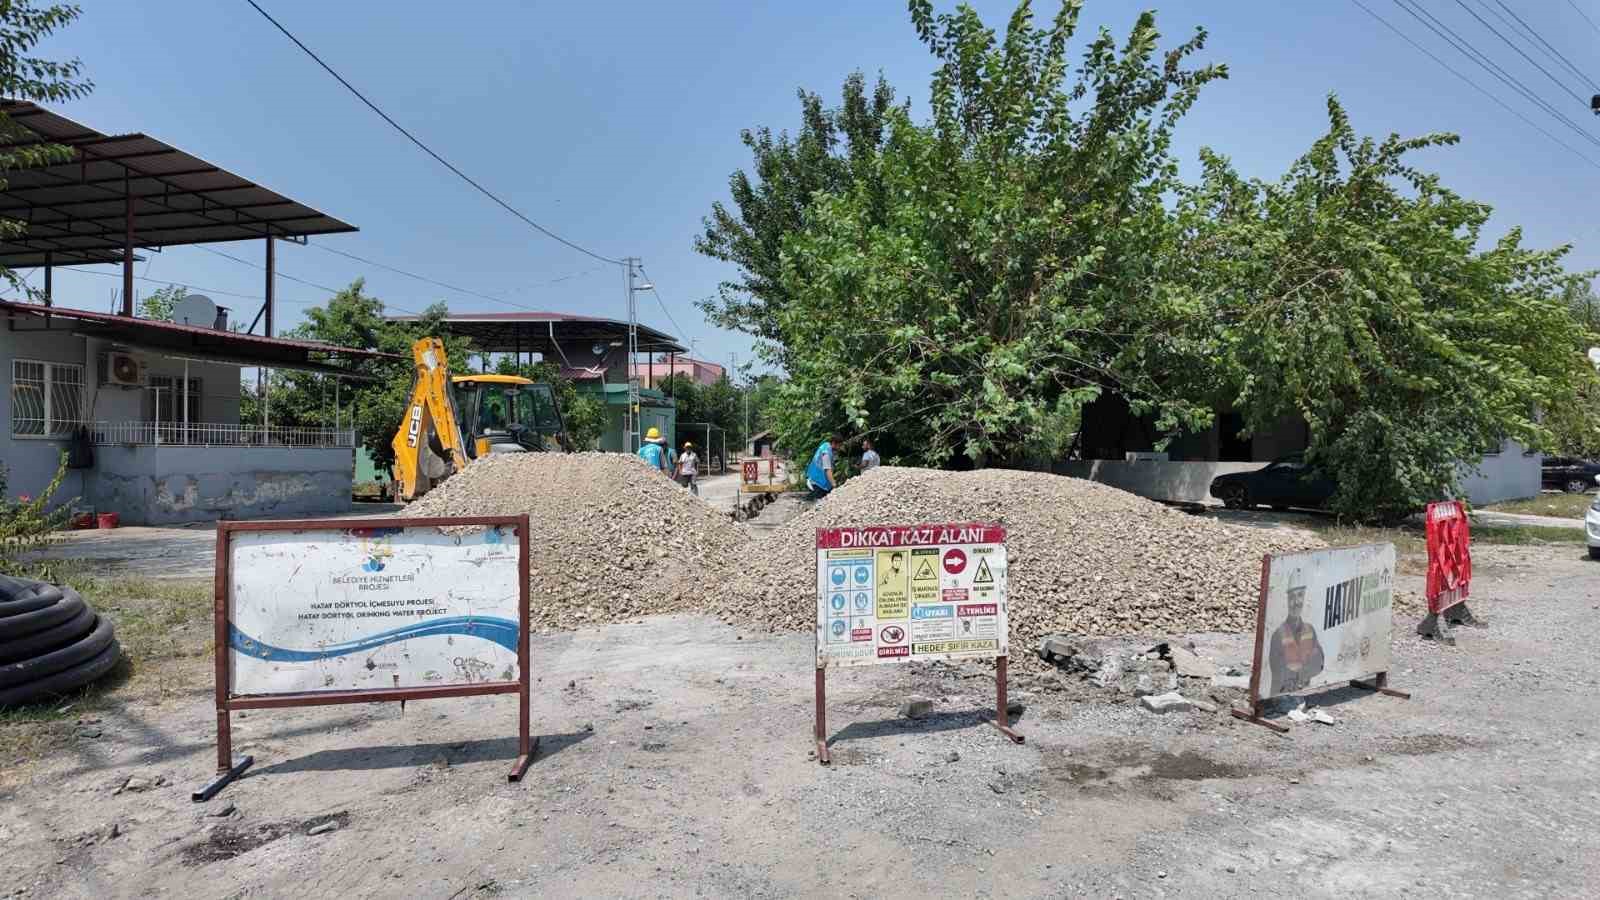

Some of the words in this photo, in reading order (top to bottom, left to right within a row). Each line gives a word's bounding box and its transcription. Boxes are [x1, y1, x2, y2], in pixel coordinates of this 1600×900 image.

[408, 406, 421, 447] JCB
[841, 529, 896, 547] DİKKAT
[900, 528, 934, 545] KAZI
[938, 527, 984, 543] ALANI
[335, 601, 367, 609] DÖRTYOL
[369, 599, 405, 608] İÇMESUYU
[967, 605, 996, 614] TEHLİKE
[1323, 576, 1364, 631] HATAY
[322, 611, 354, 620] DÖRTYOL
[356, 611, 390, 619] DRINKING
[416, 608, 448, 616] PROJECT
[918, 643, 944, 652] HEDEF
[971, 640, 993, 649] KAZA
